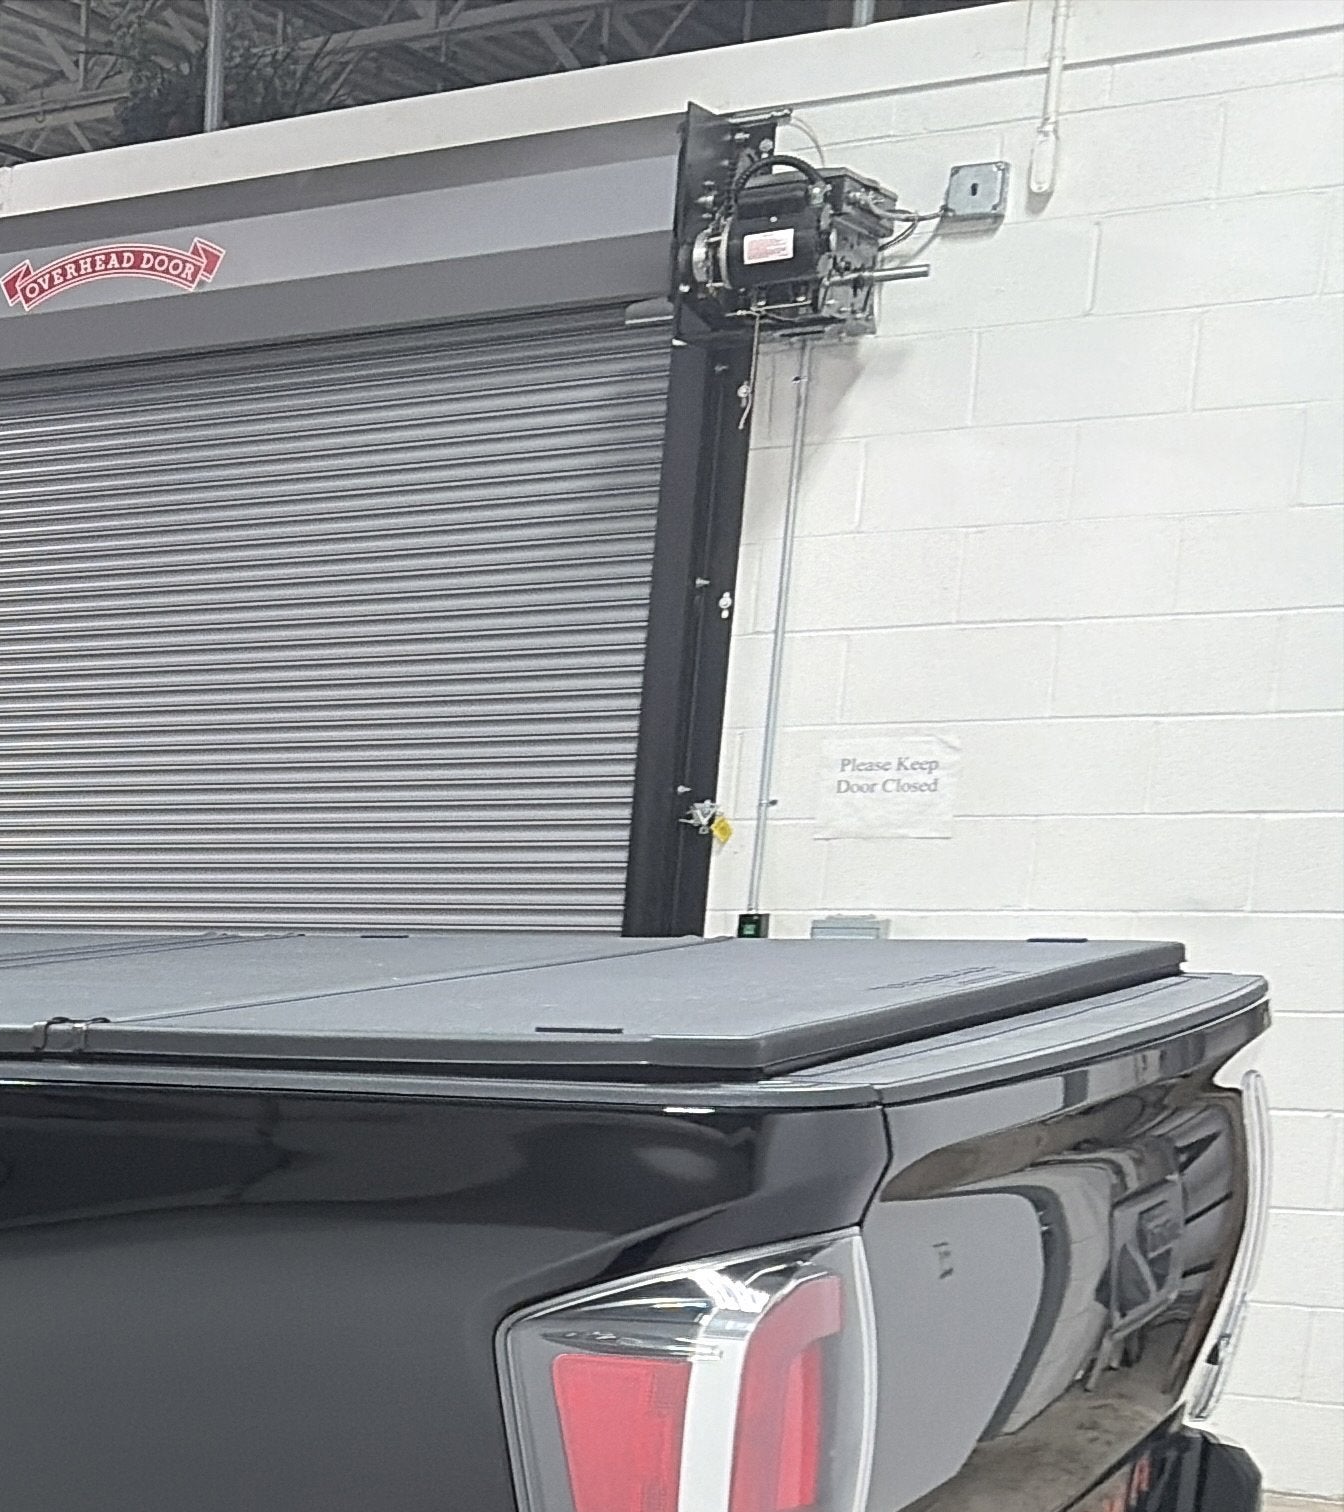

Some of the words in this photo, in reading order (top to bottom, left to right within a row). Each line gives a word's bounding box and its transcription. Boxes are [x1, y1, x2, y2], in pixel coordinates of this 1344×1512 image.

[25, 252, 134, 299] OVERHEAD
[140, 252, 195, 282] DOOR
[840, 758, 892, 772] Please
[896, 757, 939, 774] Keep
[836, 779, 878, 793] Door
[882, 778, 939, 793] Closed
